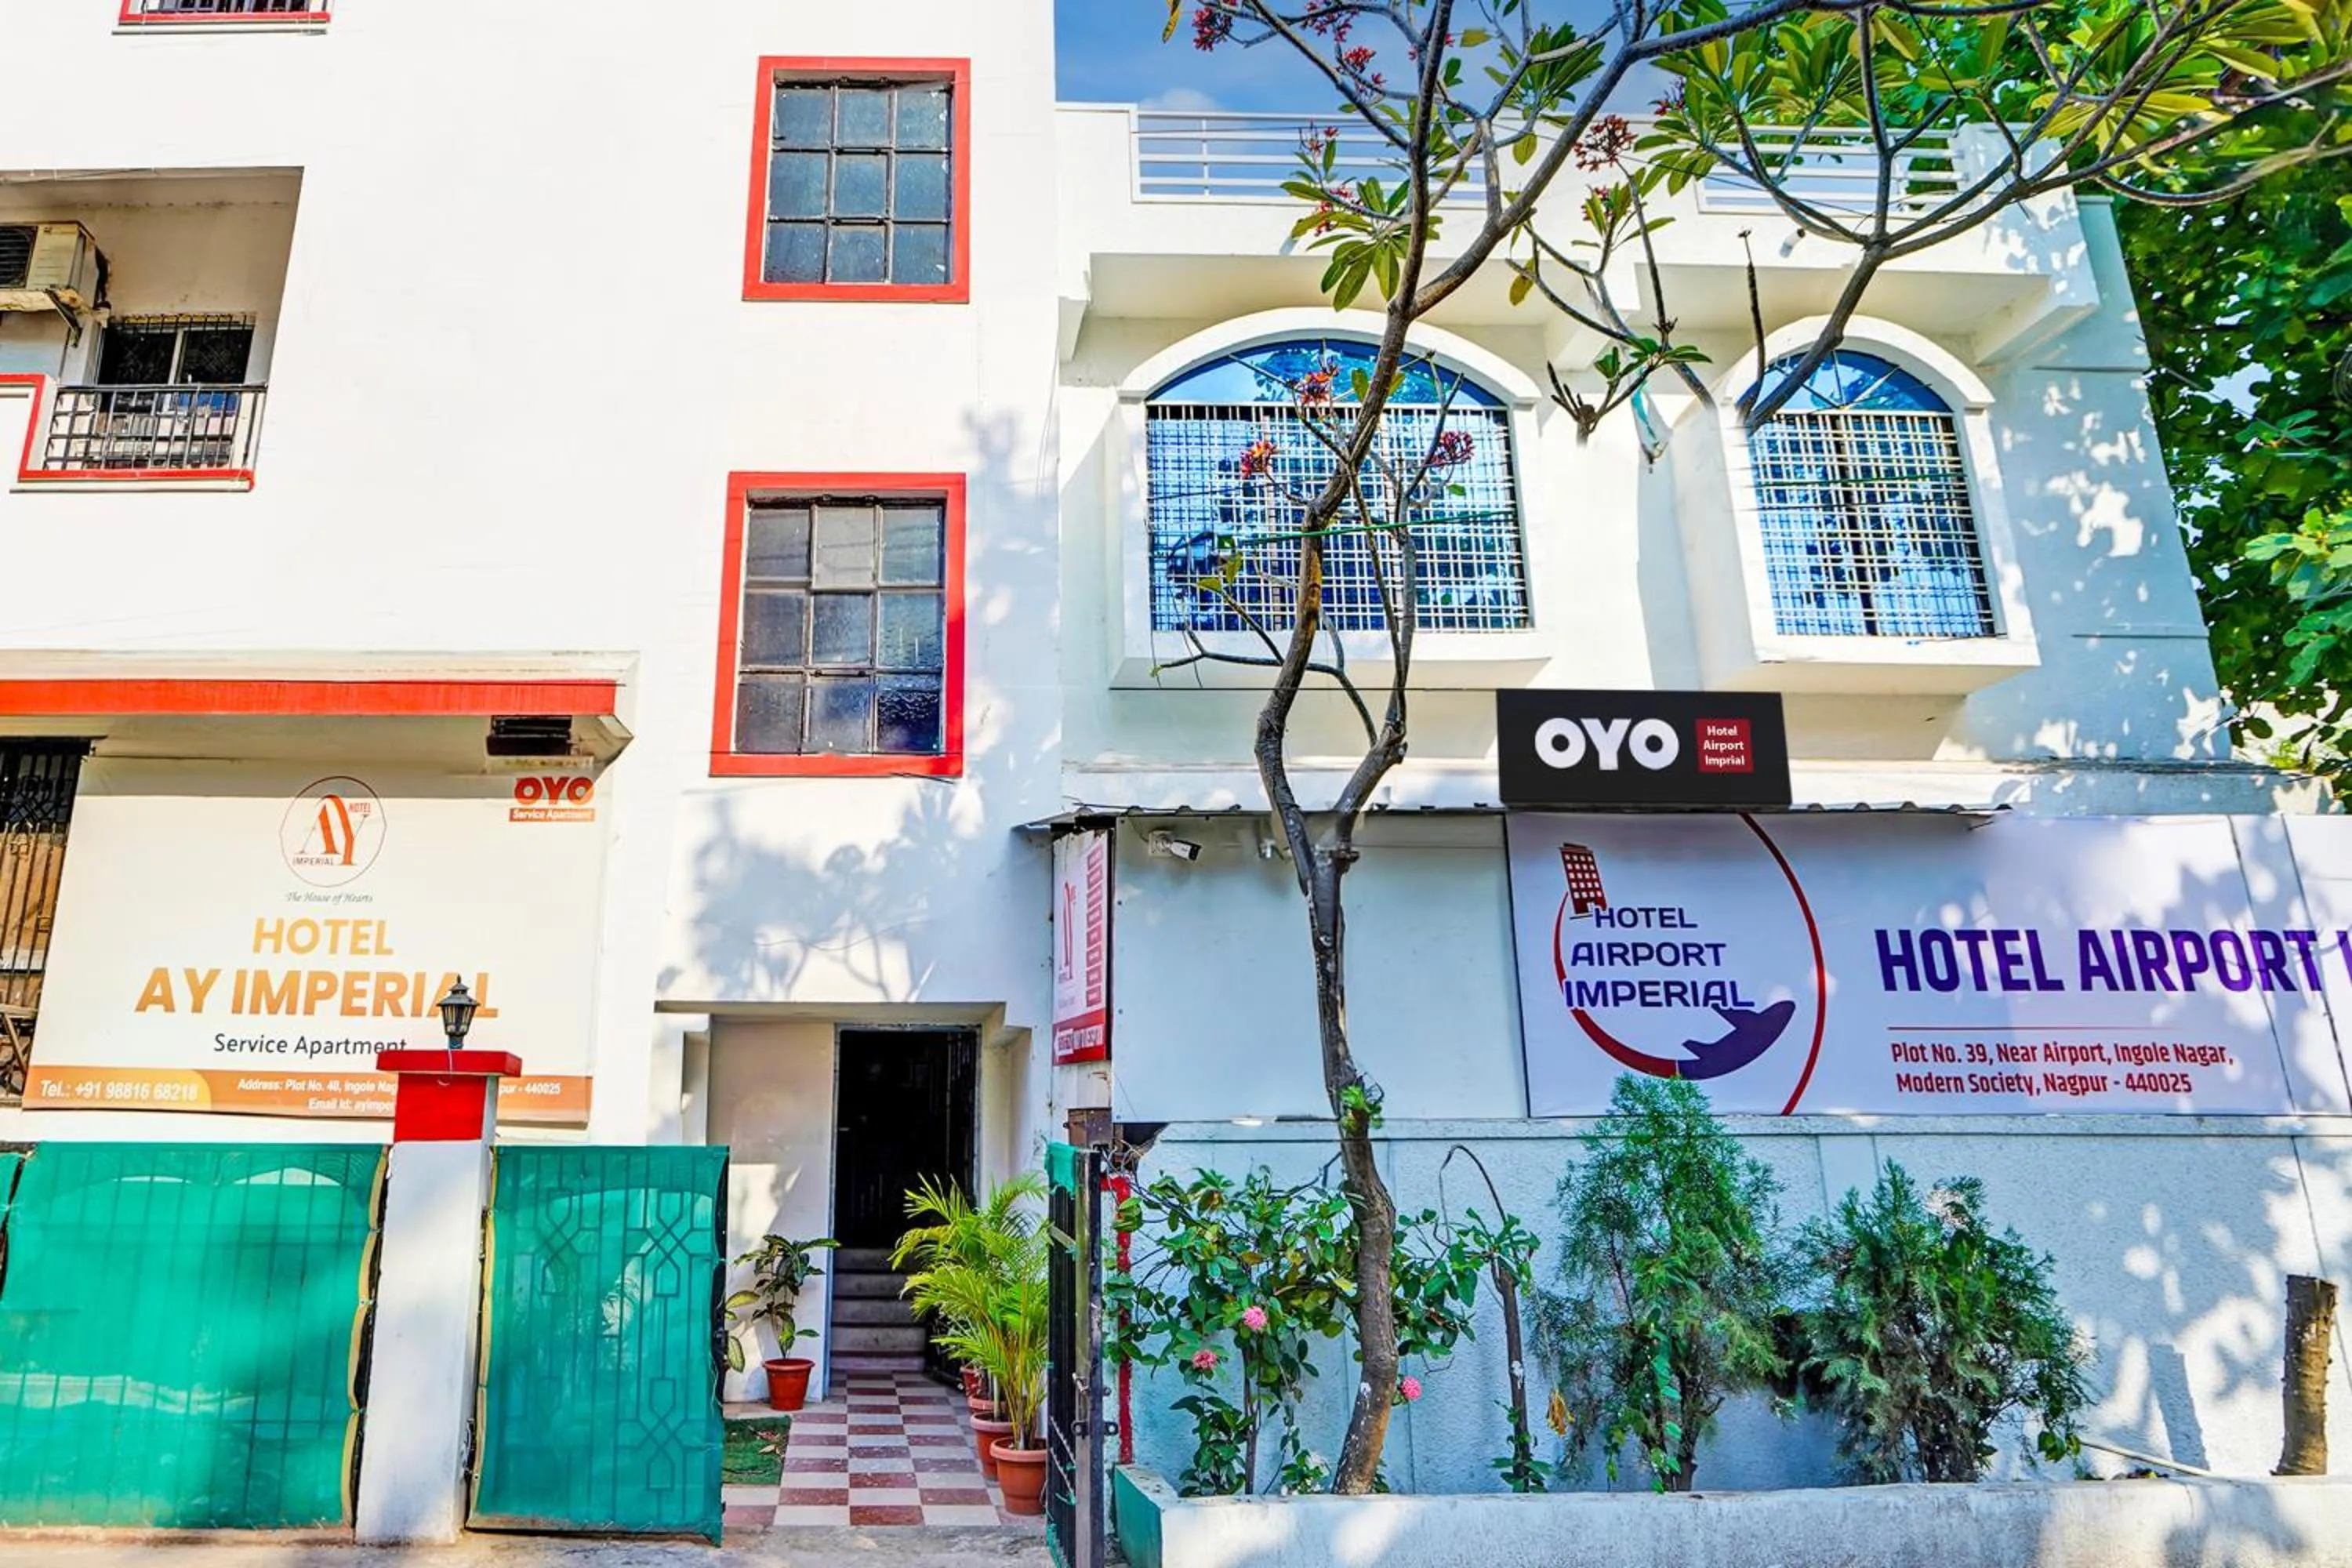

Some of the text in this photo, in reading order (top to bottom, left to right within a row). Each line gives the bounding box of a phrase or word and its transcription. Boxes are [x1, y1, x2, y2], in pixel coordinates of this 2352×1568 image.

[1707, 725, 1738, 736] Hotel
[1534, 717, 1679, 771] OYO
[1703, 739, 1744, 753] Airport
[1704, 755, 1745, 768] Imprial
[514, 776, 593, 805] OYO
[348, 802, 371, 813] HOTEL
[292, 857, 334, 866] IMPERIAL
[286, 892, 302, 902] The
[303, 894, 331, 903] House
[333, 894, 343, 905] of
[1595, 907, 1697, 929] HOTEL
[252, 917, 394, 956] HOTEL
[1571, 942, 1726, 967] AIRPORT
[1875, 928, 2065, 993] HOTEL
[2078, 929, 2322, 993] AIRPORT
[135, 967, 221, 1014] AY
[1566, 980, 1755, 1008] IMPERIAL
[214, 1033, 288, 1054] Service
[1891, 1042, 2234, 1067] Plot No. 39, Near Airport, Ingole Nagar,
[41, 1080, 71, 1098] Tel.:
[74, 1082, 102, 1098] +91
[238, 1078, 282, 1091] Address:
[285, 1080, 307, 1091] Plot
[307, 1080, 325, 1092] No.
[344, 1081, 376, 1094] Ingole
[377, 1083, 398, 1095] Nag
[1896, 1073, 1965, 1093] Modern
[1968, 1073, 2041, 1097] Society,
[2043, 1073, 2108, 1096] Nagpur
[2125, 1073, 2193, 1093] 440025
[308, 1098, 340, 1110] Email
